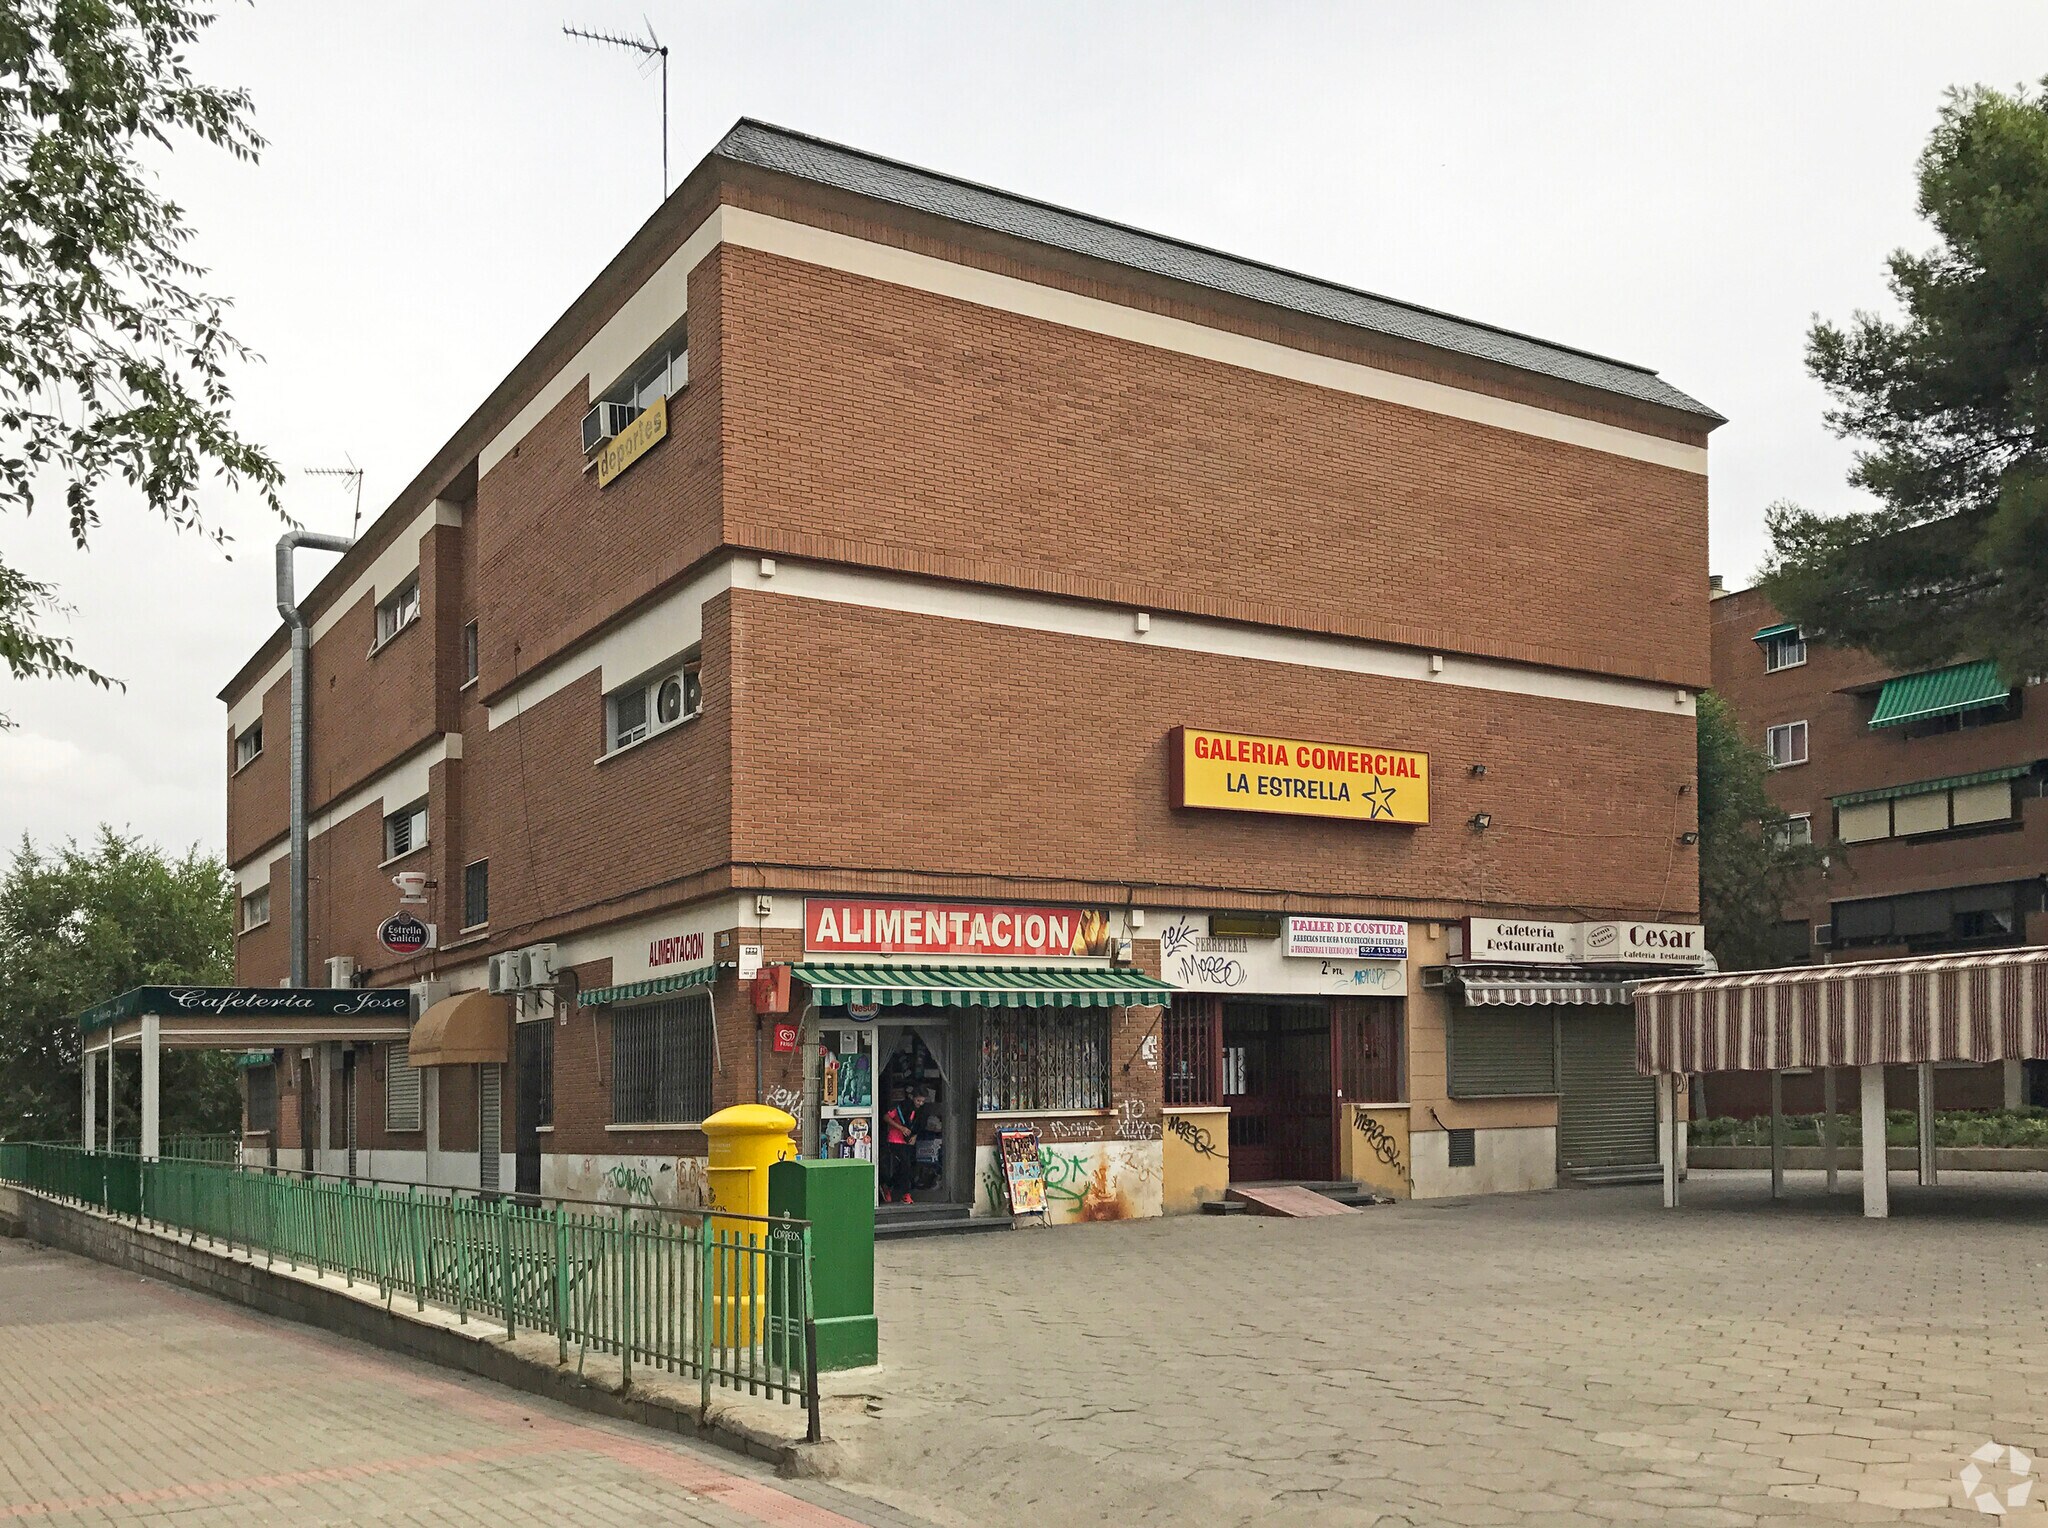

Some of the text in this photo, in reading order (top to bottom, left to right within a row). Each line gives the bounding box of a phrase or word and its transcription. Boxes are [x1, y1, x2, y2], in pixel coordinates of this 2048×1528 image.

[601, 411, 662, 477] deportes
[1194, 736, 1421, 779] GALERIA COMERCIAL
[1226, 772, 1350, 802] LA ESTRELLA
[388, 925, 422, 935] Estrella
[389, 933, 420, 943] Galicia
[814, 907, 1069, 949] ALIMENTACION
[1291, 919, 1405, 935] TALLER DE COSTURA
[1629, 925, 1696, 948] Cesar
[649, 932, 704, 968] ALIMENTACION
[1195, 937, 1248, 953] FERRETERIA
[1487, 938, 1564, 953] Restaurante
[333, 991, 407, 1014] Jose
